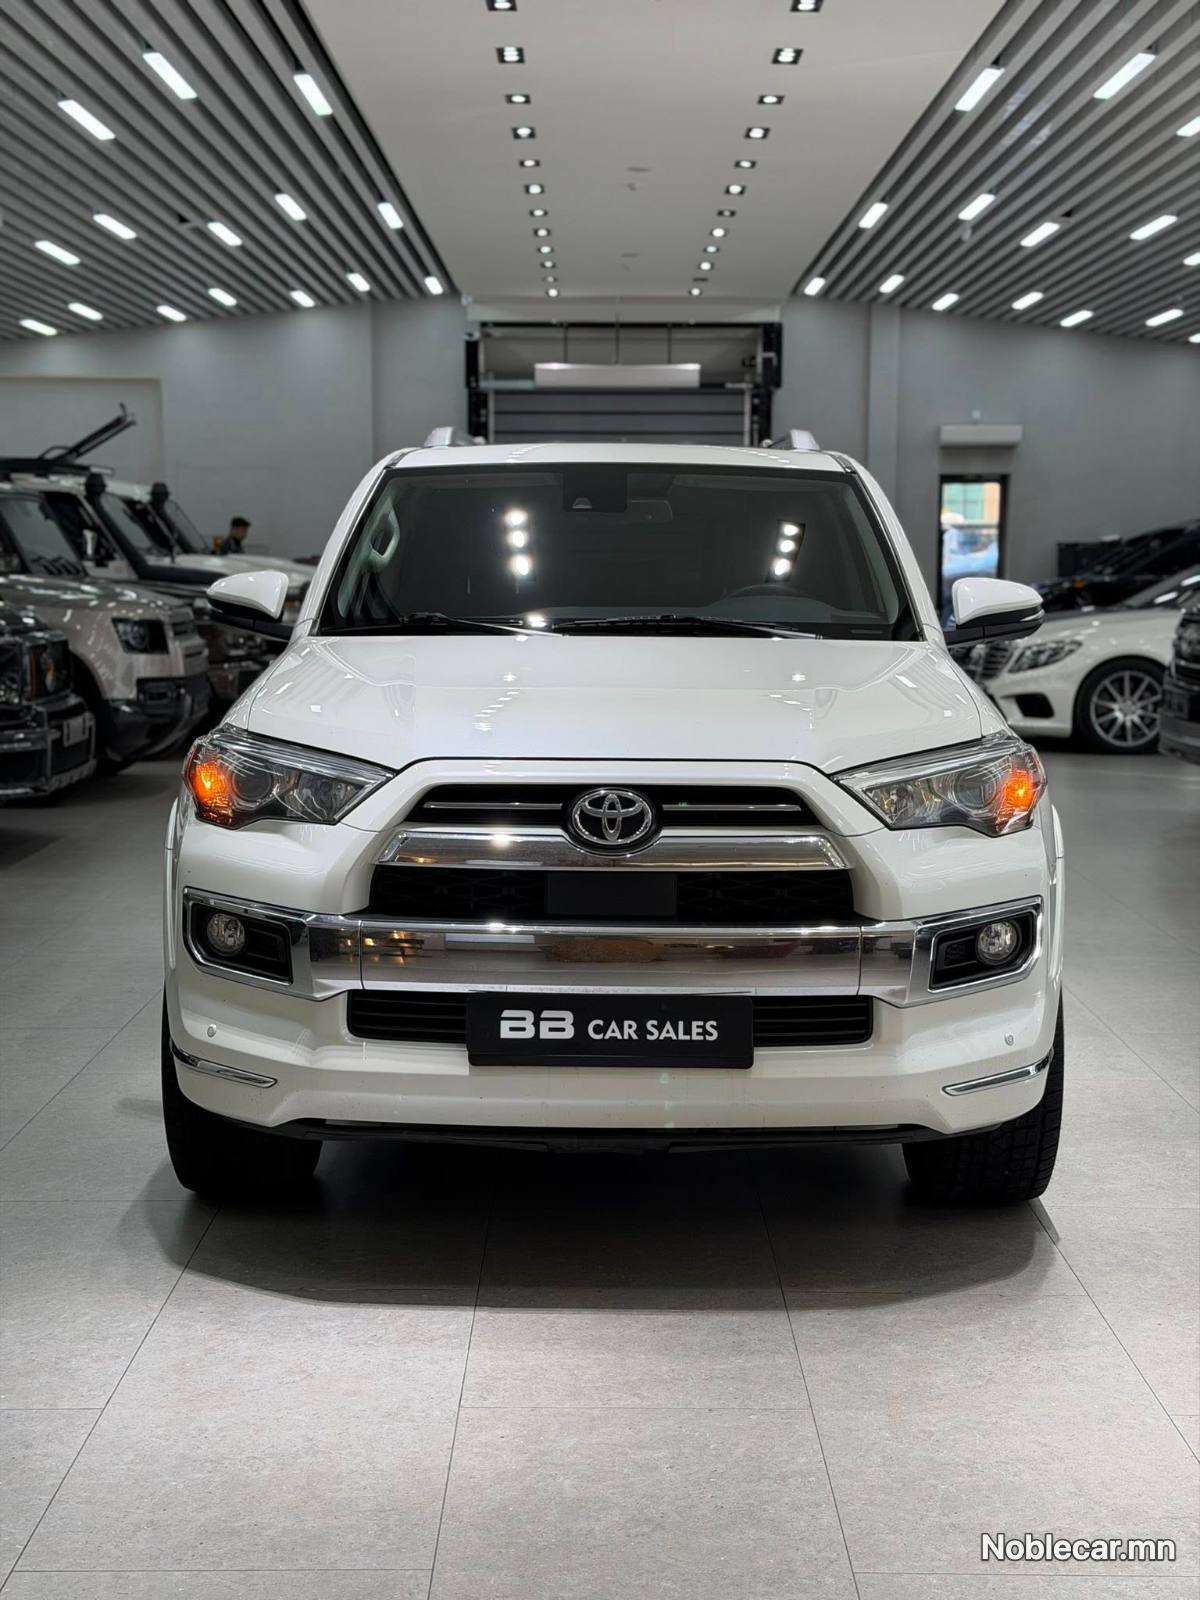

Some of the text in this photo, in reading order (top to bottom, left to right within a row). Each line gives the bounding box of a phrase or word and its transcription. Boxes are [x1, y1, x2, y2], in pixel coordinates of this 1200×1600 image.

[500, 1009, 719, 1041] BB CAR SALES
